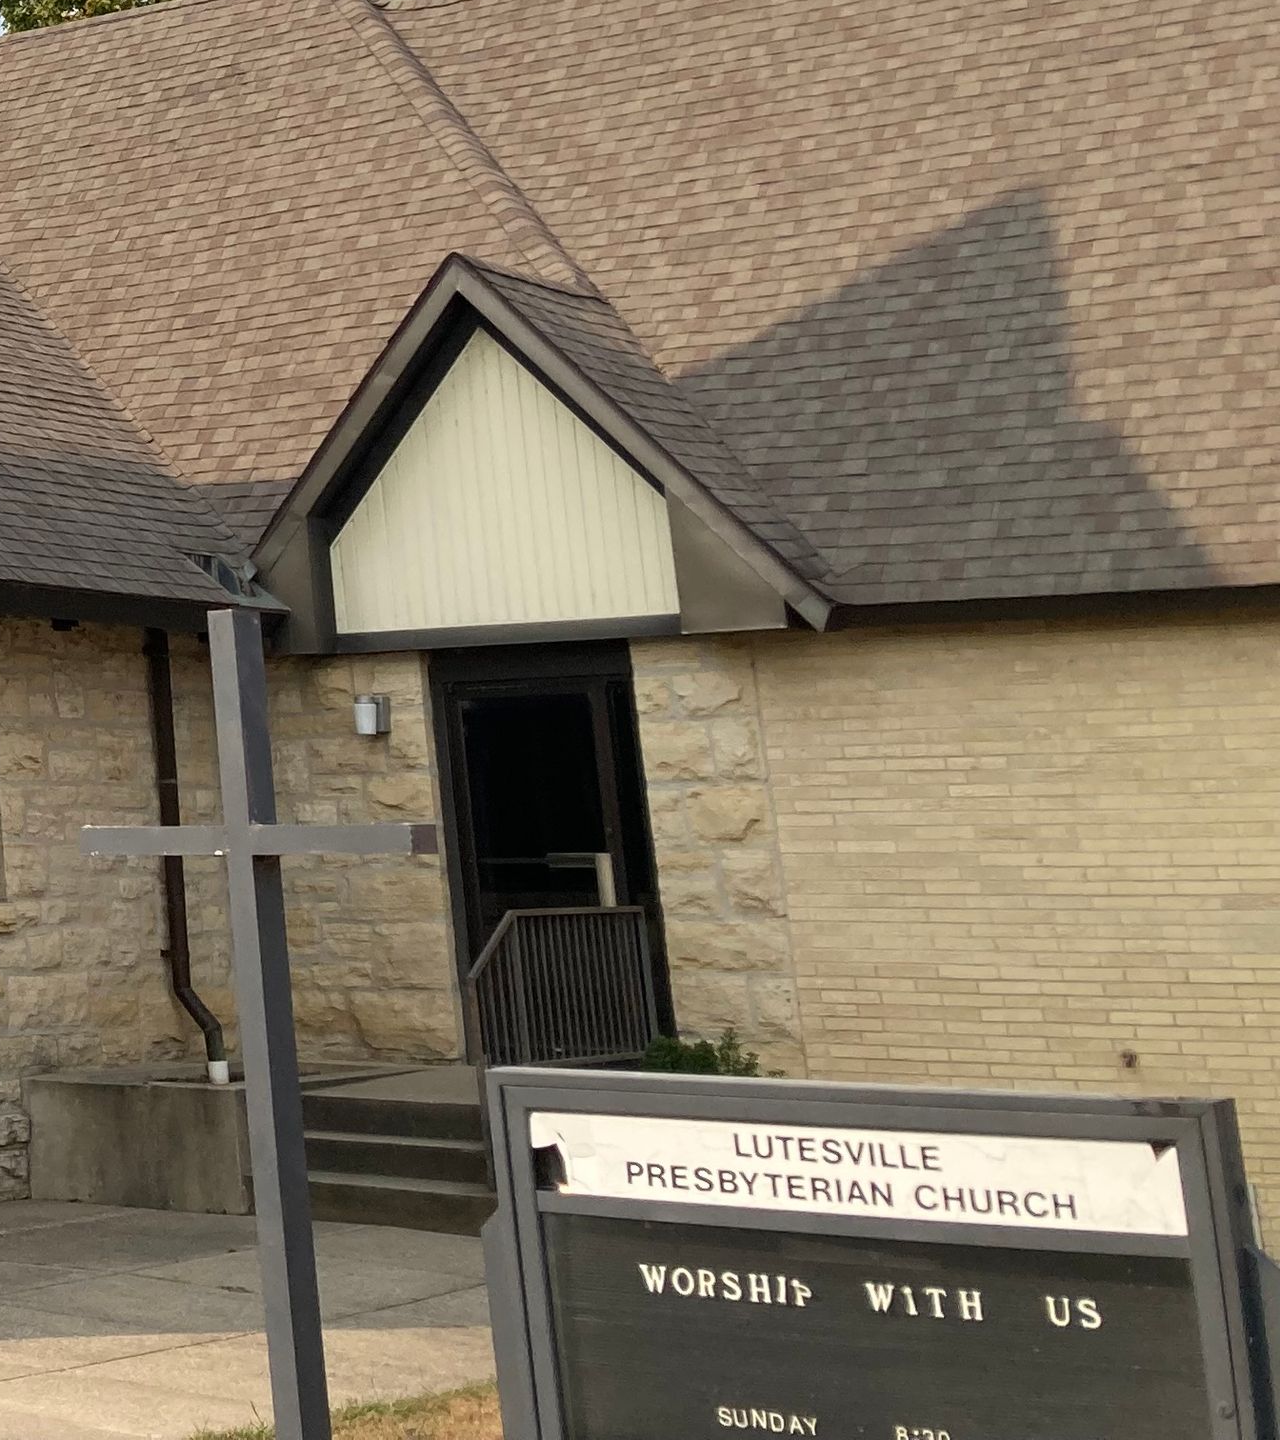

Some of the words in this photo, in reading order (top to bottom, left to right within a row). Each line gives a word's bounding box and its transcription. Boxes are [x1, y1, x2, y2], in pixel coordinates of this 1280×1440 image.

[732, 1132, 942, 1171] LUTESVILLE
[626, 1161, 894, 1207] PRESBYTERIAN
[914, 1184, 1078, 1220] CHURCH
[639, 1263, 813, 1307] WORSHIP
[1045, 1296, 1103, 1329] US
[717, 1407, 817, 1436] SUNDAY
